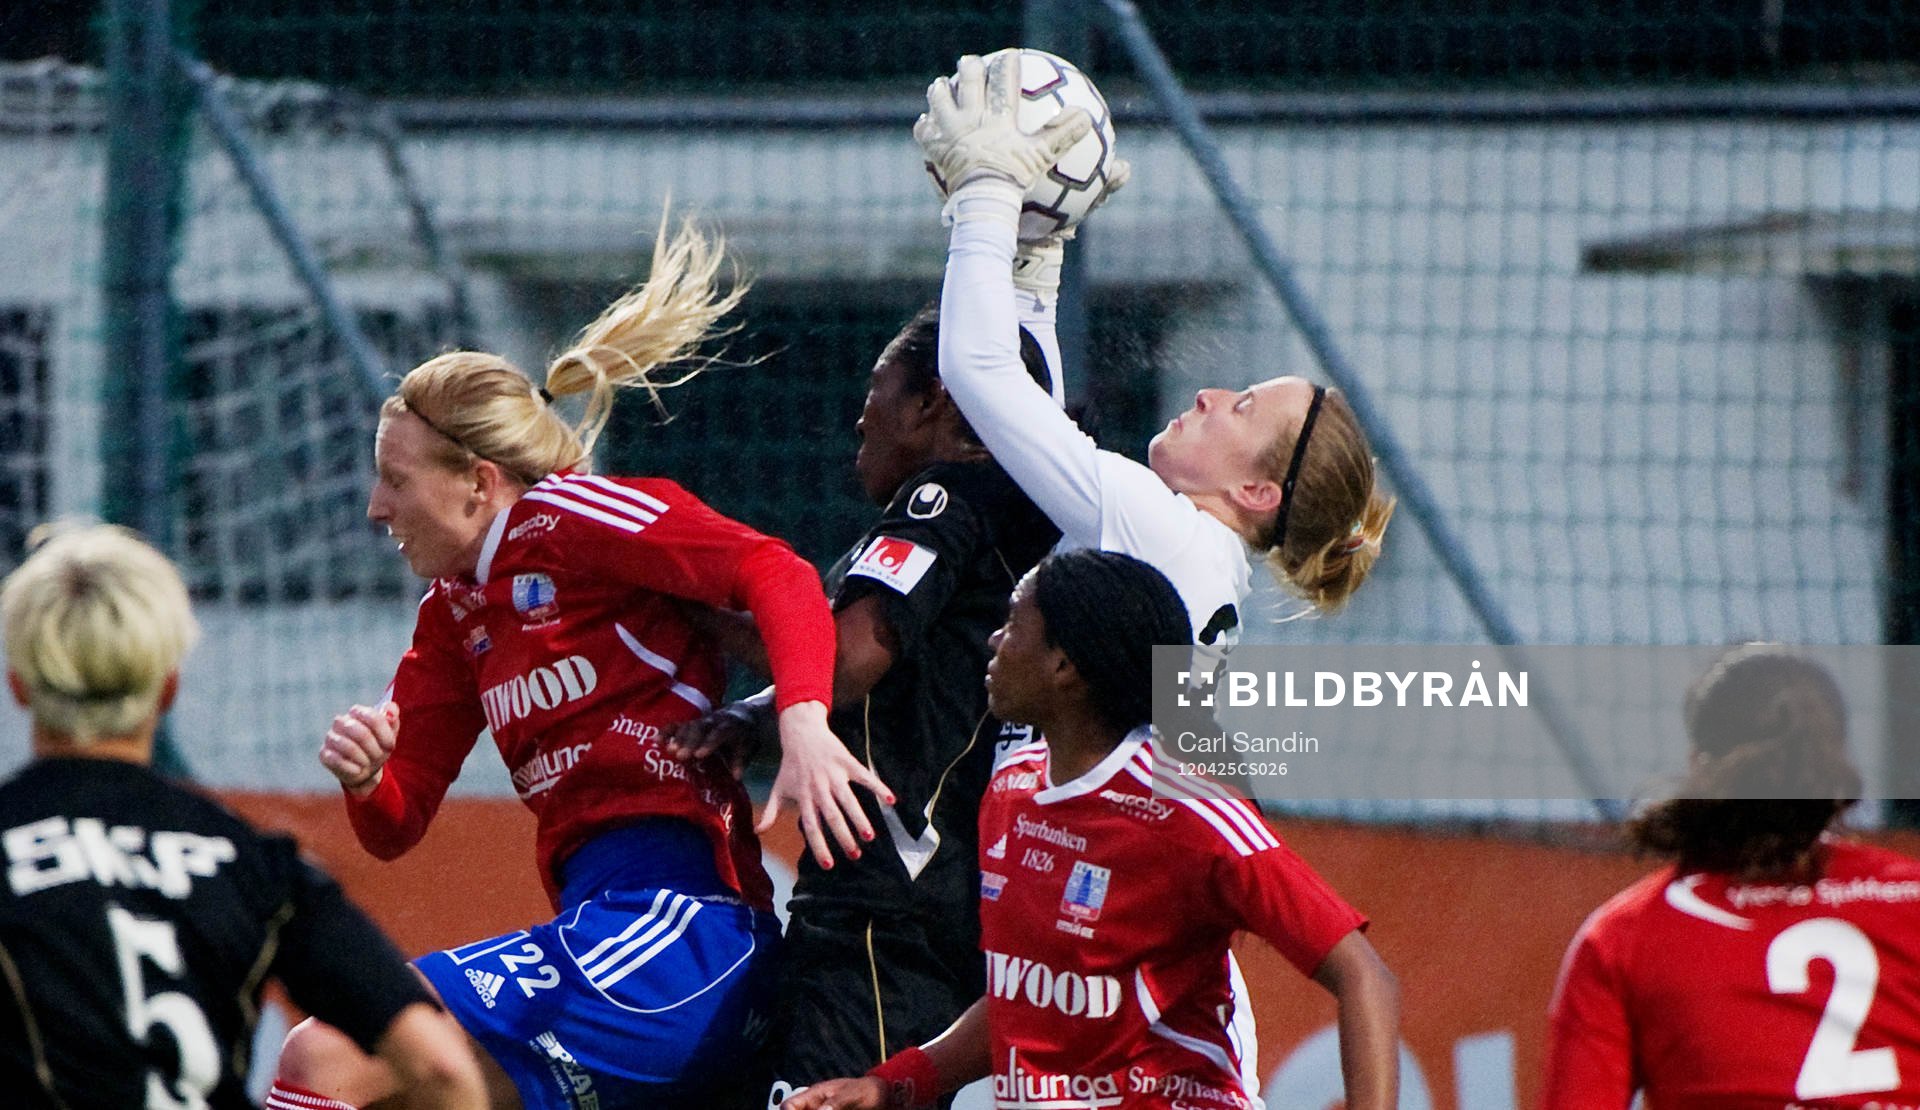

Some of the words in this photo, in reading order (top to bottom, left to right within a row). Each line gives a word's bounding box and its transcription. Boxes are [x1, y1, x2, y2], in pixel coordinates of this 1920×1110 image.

[1013, 813, 1088, 853] Sparbanken
[1020, 847, 1056, 873] 1826
[464, 968, 496, 1009] adidas
[498, 942, 561, 999] 22
[106, 903, 222, 1110] 5
[1765, 916, 1901, 1100] 2
